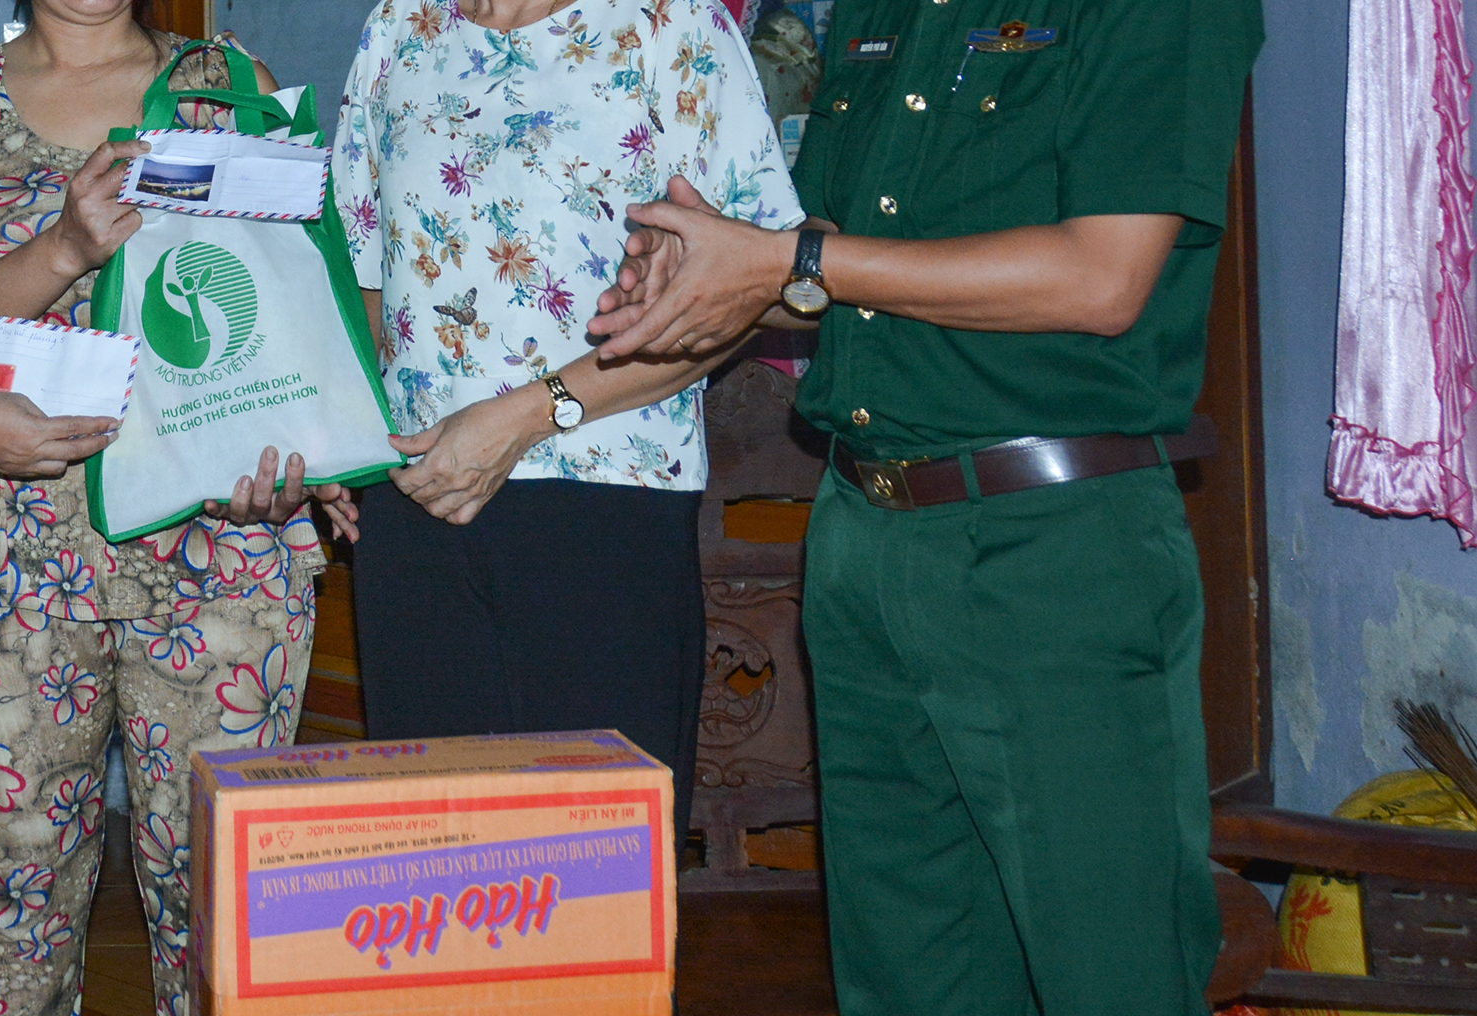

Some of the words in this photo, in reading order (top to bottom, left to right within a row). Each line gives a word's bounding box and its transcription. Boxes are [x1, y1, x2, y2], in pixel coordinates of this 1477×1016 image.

[154, 364, 177, 385] MÔI
[177, 368, 223, 388] TRƯỜNG
[222, 357, 247, 377] VIỆT
[243, 333, 267, 363] NAM
[204, 389, 232, 407] ỨNG
[233, 379, 270, 398] CHIẾN
[272, 372, 302, 390] DỊCH
[156, 422, 179, 437] LÀM
[180, 415, 204, 433] CHO
[204, 405, 229, 423] THẾ
[229, 399, 256, 416] GIỚI
[258, 392, 290, 410] SẠCH
[291, 385, 319, 401] HƠN
[375, 819, 402, 833] DỤNG
[569, 809, 598, 826] LIỀN
[602, 808, 618, 822] ĂN
[622, 807, 635, 822] MÌ
[307, 825, 335, 838] NƯỚC
[337, 823, 372, 835] TRONG
[619, 834, 641, 861] SẢN
[343, 867, 369, 888] NAM
[371, 861, 397, 889] VIỆT
[406, 861, 421, 891] SỐ
[422, 854, 453, 879] CHẠY
[289, 874, 301, 895] 18
[303, 870, 342, 893] TRONG
[456, 874, 558, 949] Hảo
[344, 894, 449, 970] Hảo
